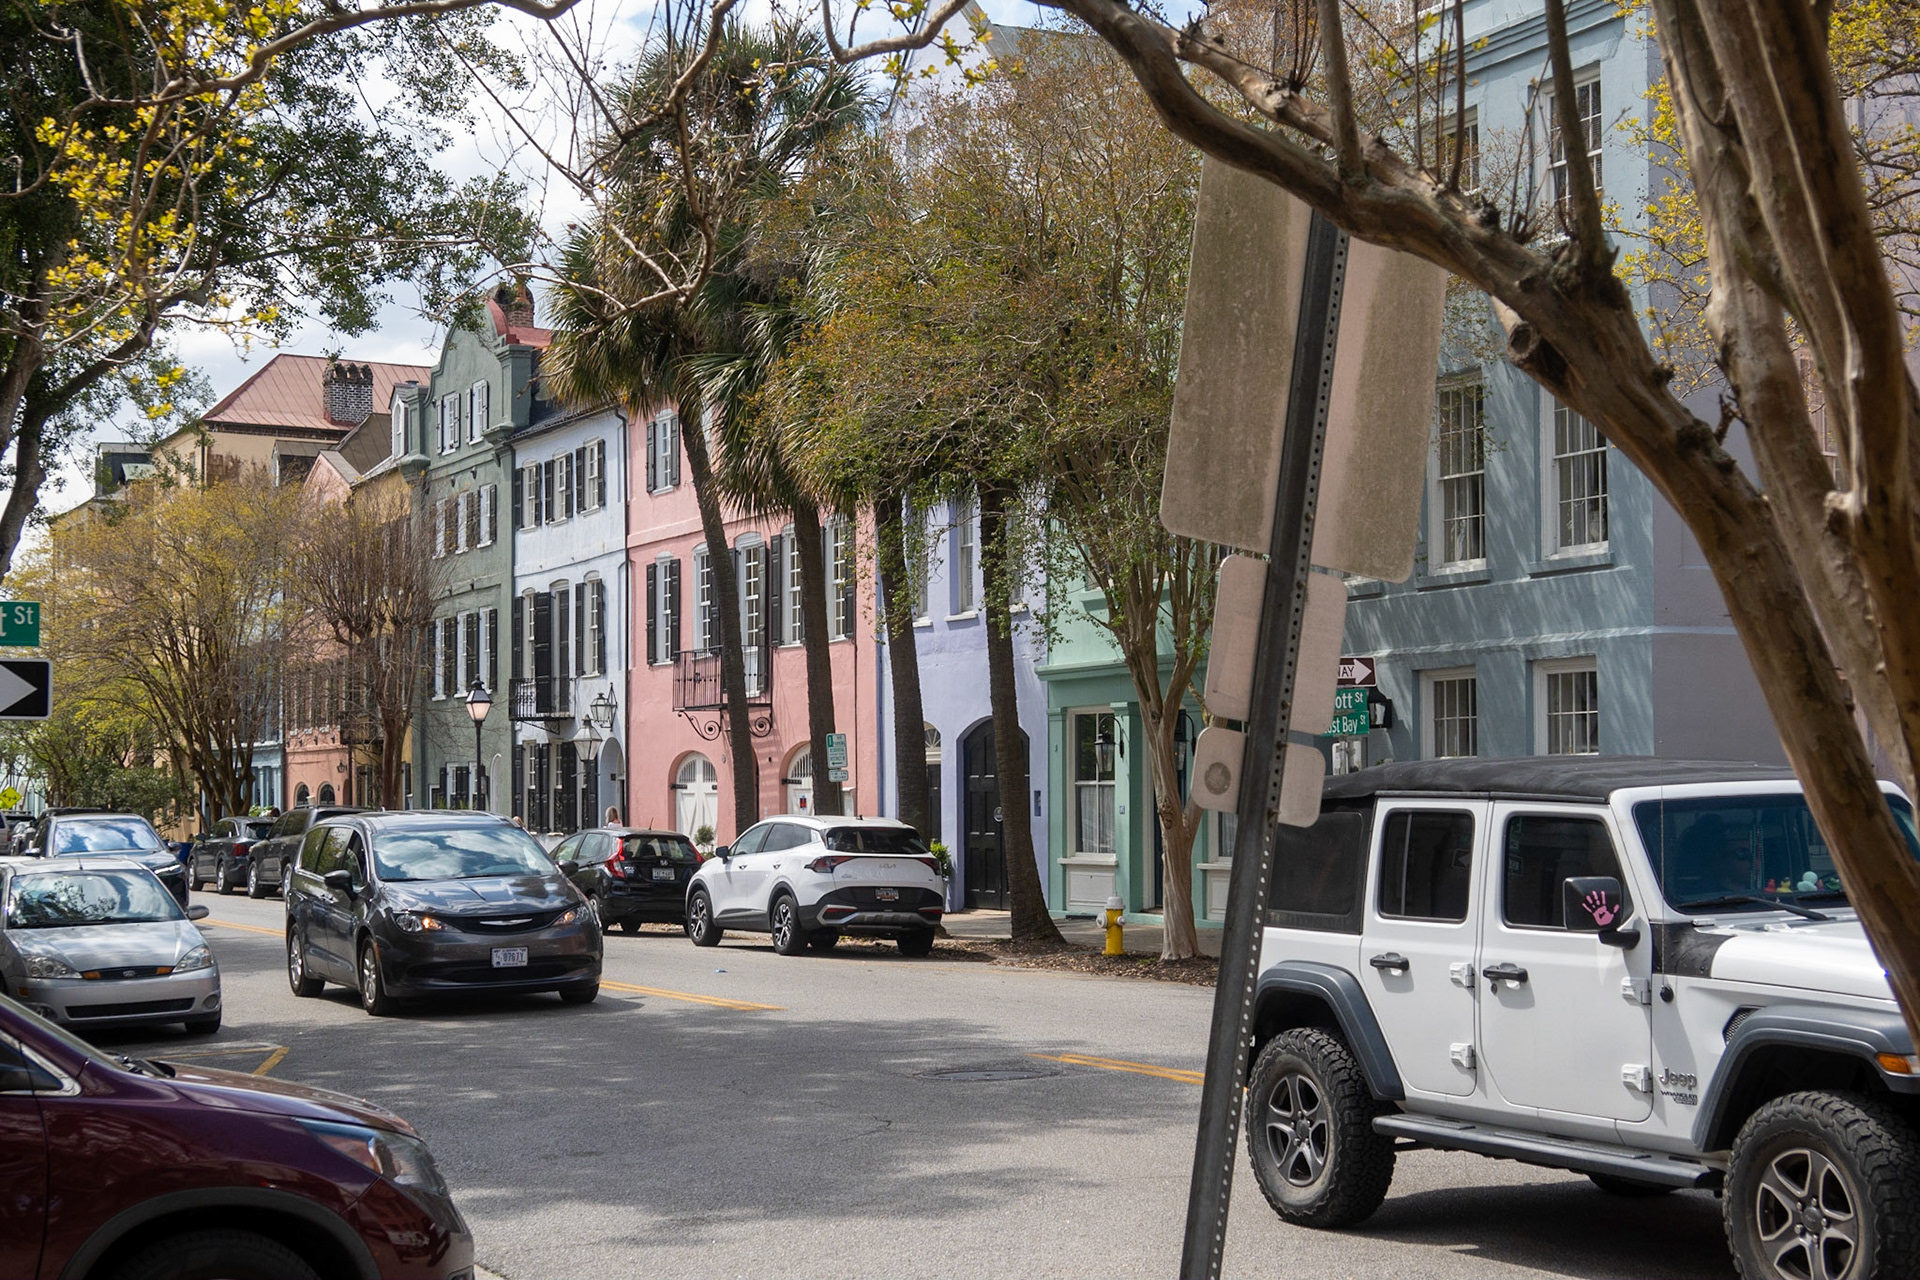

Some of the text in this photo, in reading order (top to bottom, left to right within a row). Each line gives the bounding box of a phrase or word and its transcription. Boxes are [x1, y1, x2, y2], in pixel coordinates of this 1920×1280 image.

[14, 605, 34, 625] St
[1335, 691, 1364, 709] ott St
[1342, 715, 1358, 735] Bay
[1360, 714, 1367, 725] St
[1658, 1066, 1697, 1091] Jeep
[1660, 1089, 1698, 1099] WRANGLER
